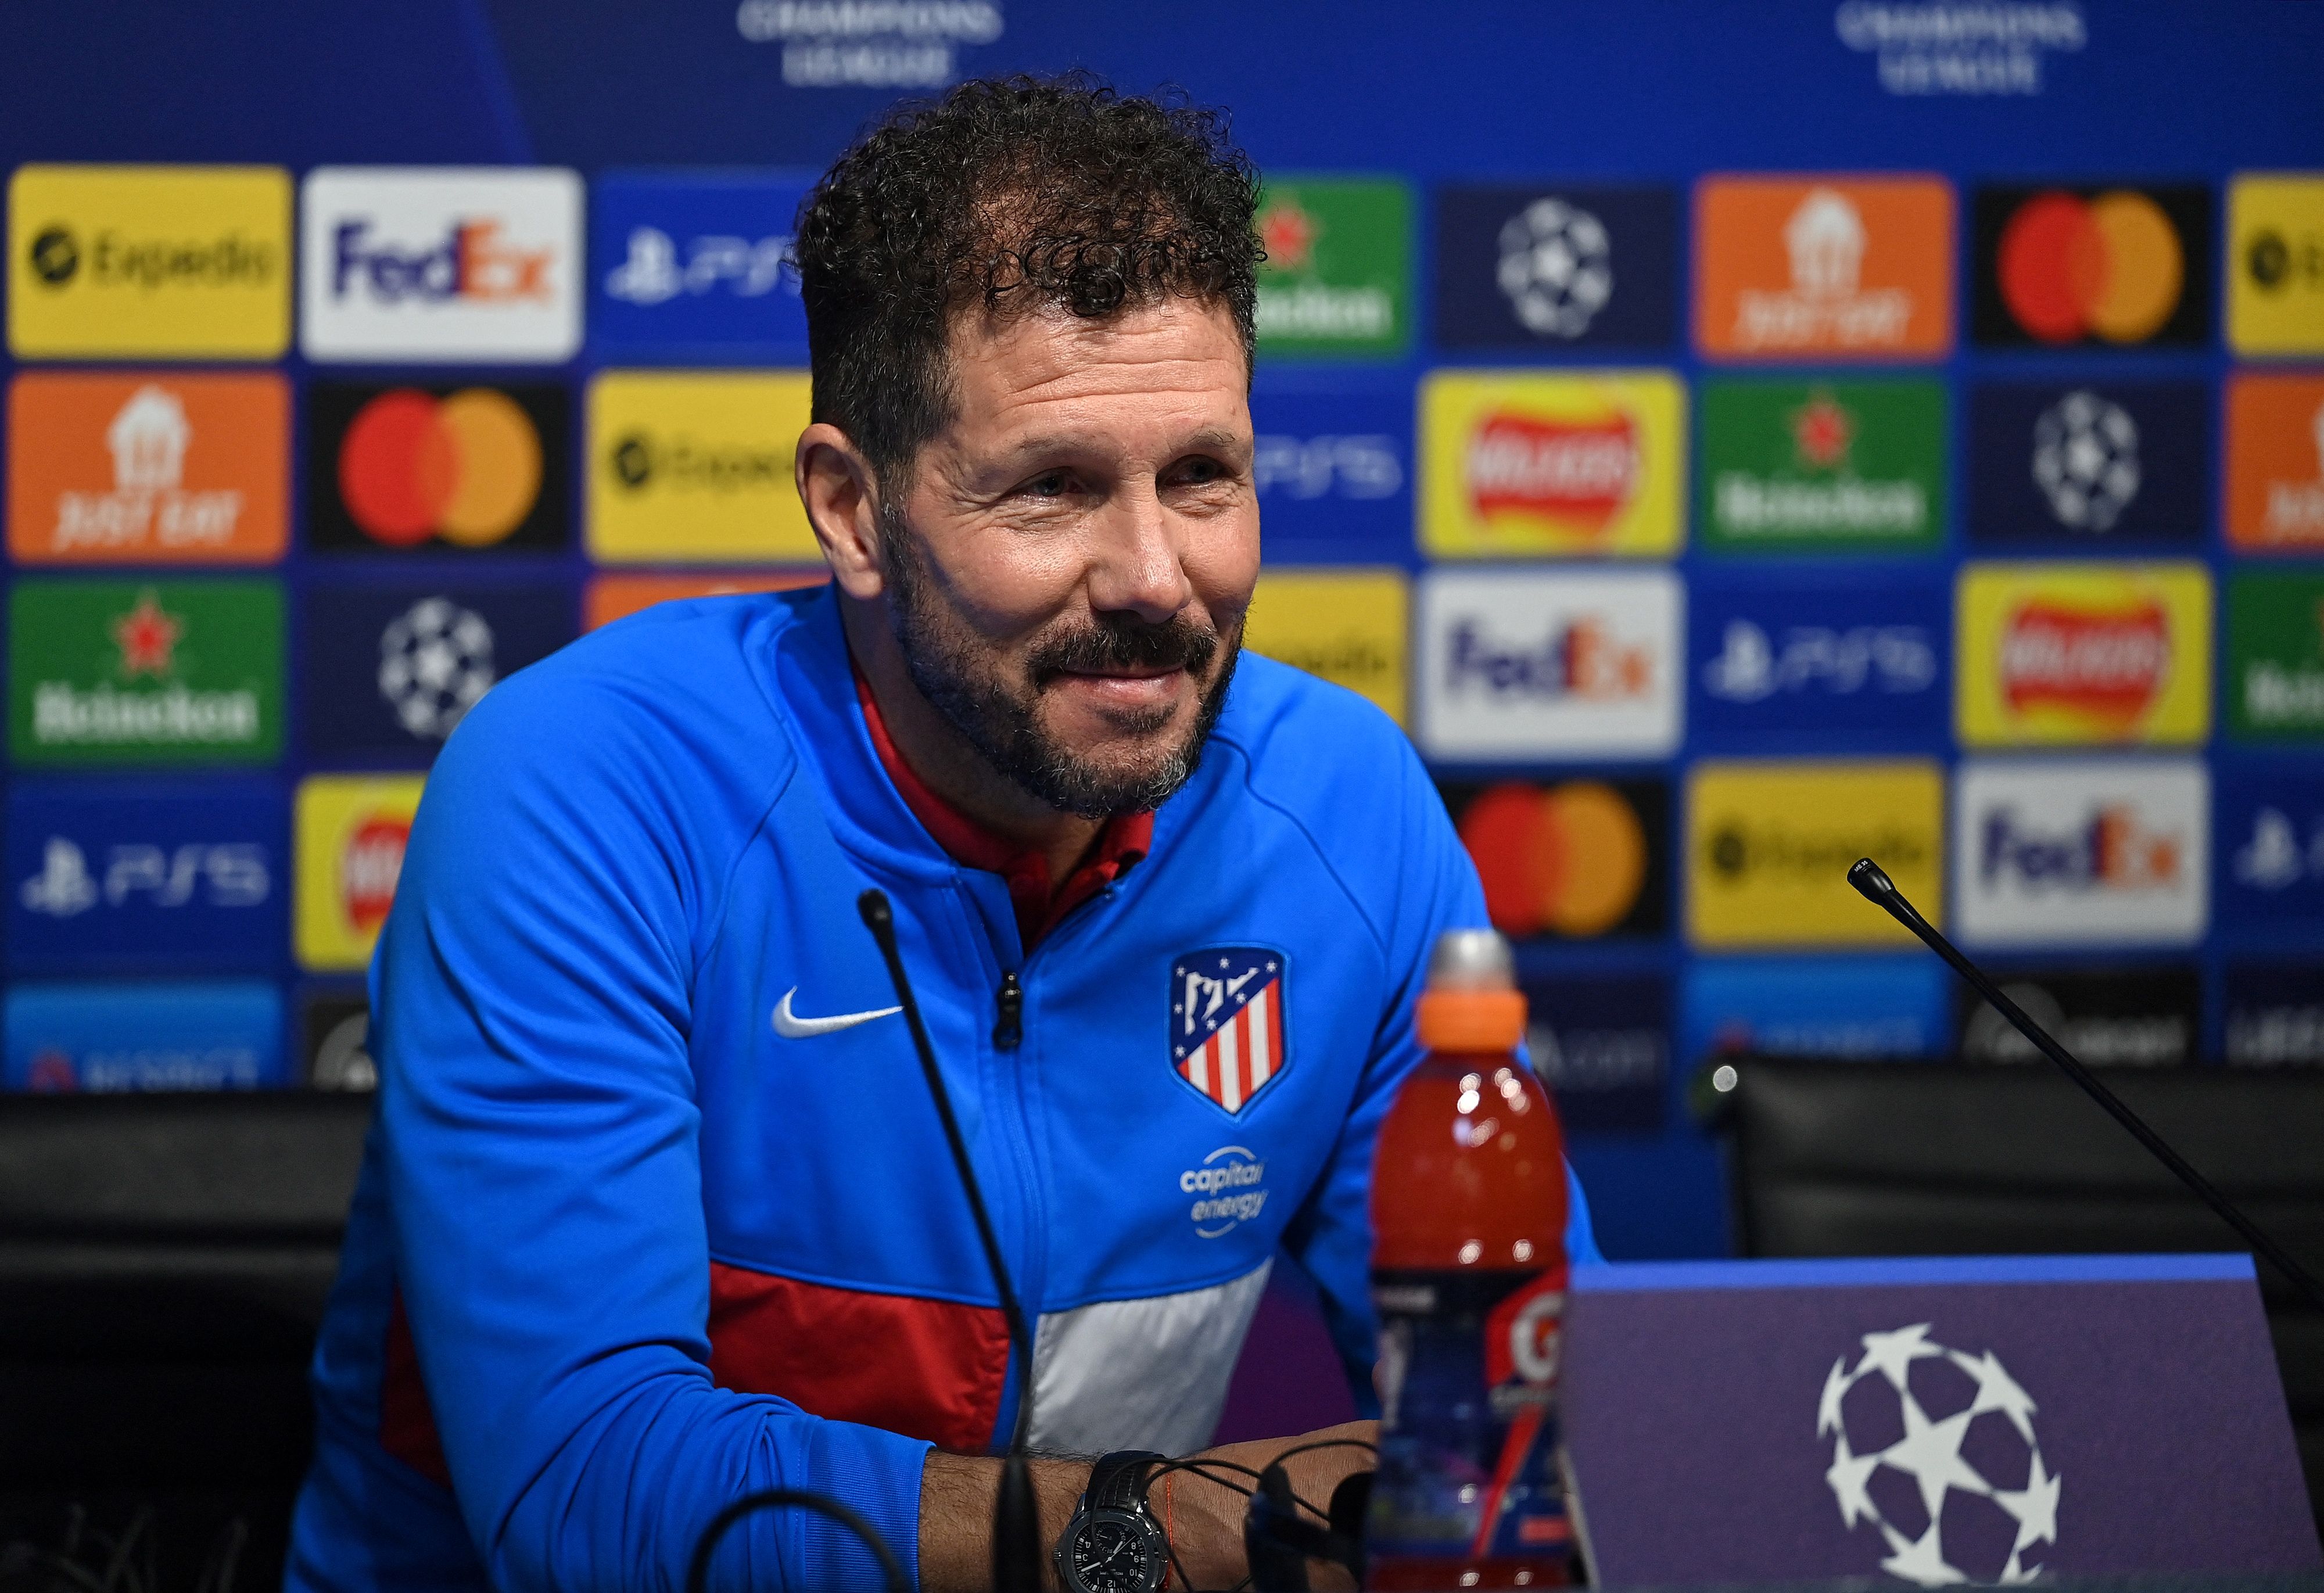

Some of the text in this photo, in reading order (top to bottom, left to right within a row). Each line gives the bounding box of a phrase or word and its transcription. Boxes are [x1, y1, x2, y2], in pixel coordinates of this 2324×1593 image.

[738, 0, 1002, 41] CHAMPIONS
[784, 44, 949, 85] LEAGUE
[1882, 51, 2038, 93] LEAGUE
[91, 231, 273, 292] Expedia
[332, 215, 558, 304] FedEx
[1735, 292, 1829, 349] JUST
[53, 491, 242, 550] JUST EAT
[1716, 473, 1925, 532] Heineken
[1448, 617, 1651, 701] FedEx
[1781, 626, 1934, 689] PS5
[35, 682, 258, 740] Heineken
[107, 845, 268, 905] PS5
[1980, 805, 2178, 890] FedEx
[1179, 1158, 1267, 1196] capital
[1191, 1190, 1269, 1221] energy
